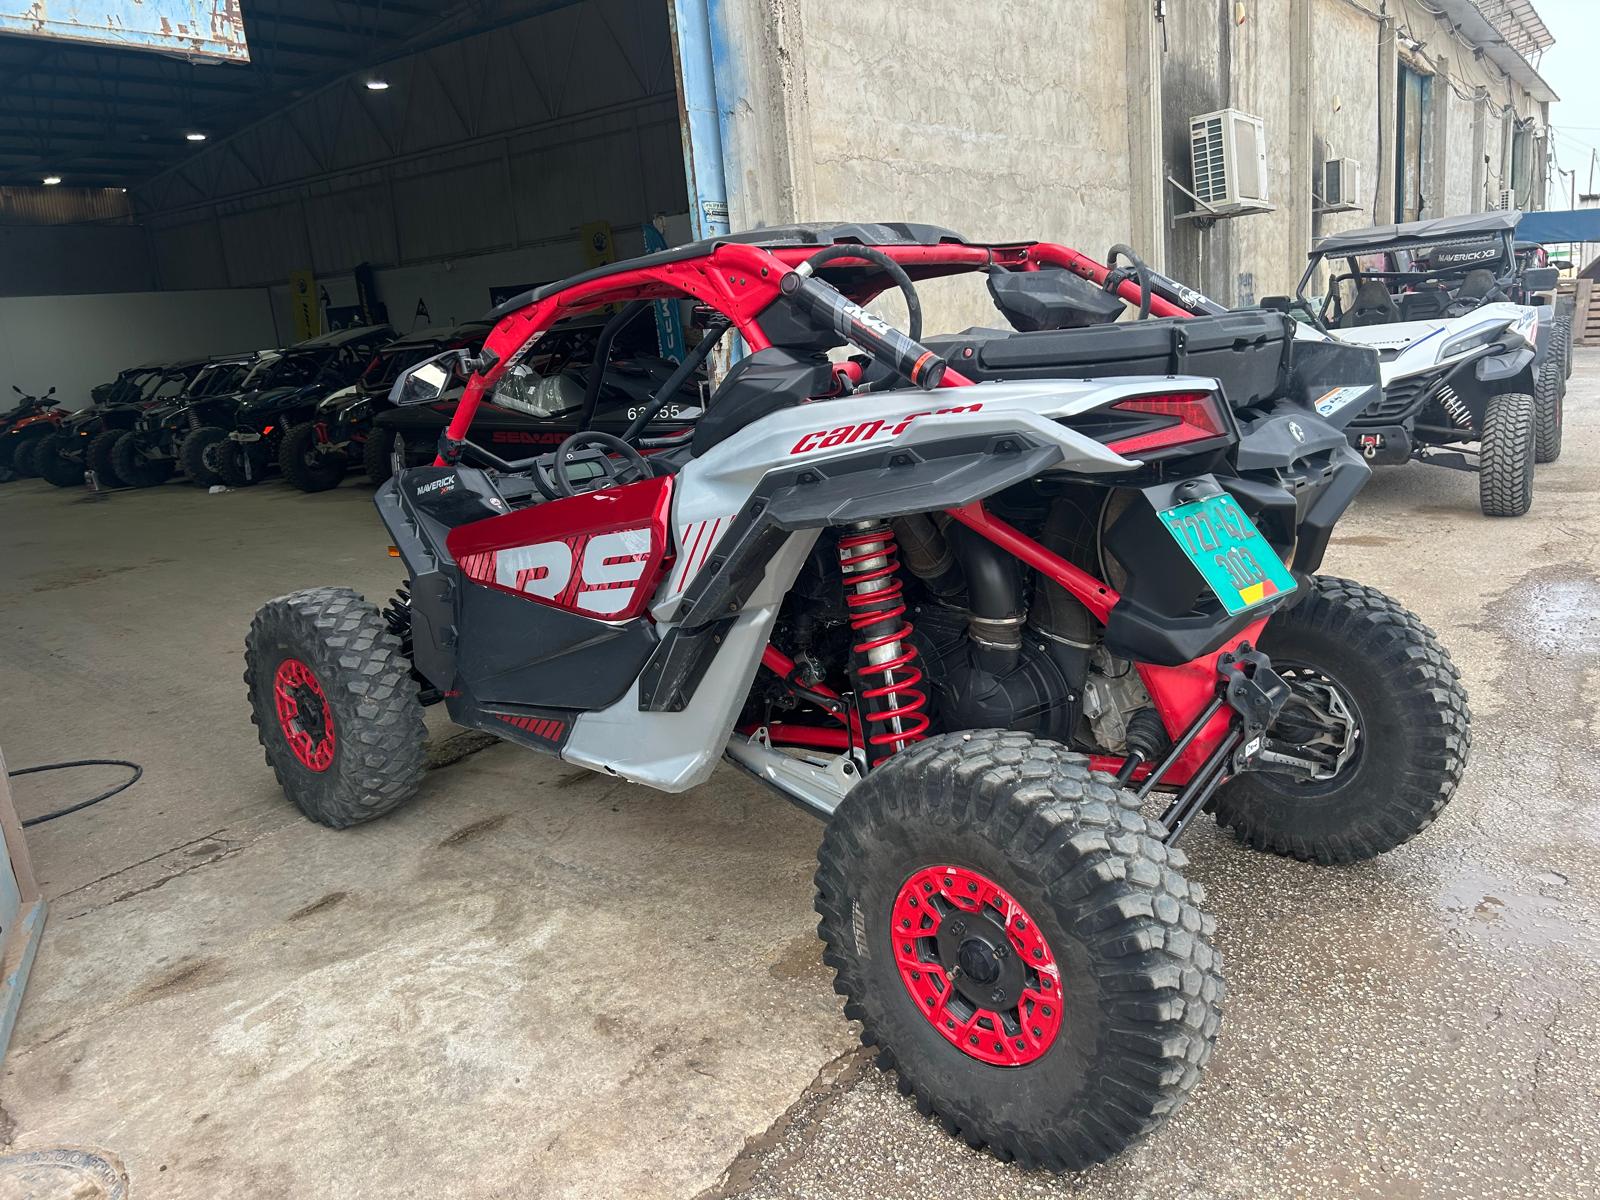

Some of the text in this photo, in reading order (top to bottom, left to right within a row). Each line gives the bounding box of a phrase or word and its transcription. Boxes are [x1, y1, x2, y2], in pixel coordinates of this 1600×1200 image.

[1438, 249, 1496, 262] MAVERICK X3
[417, 475, 455, 496] MAVERICK
[1170, 504, 1256, 556] 727-42
[1214, 547, 1267, 590] 303
